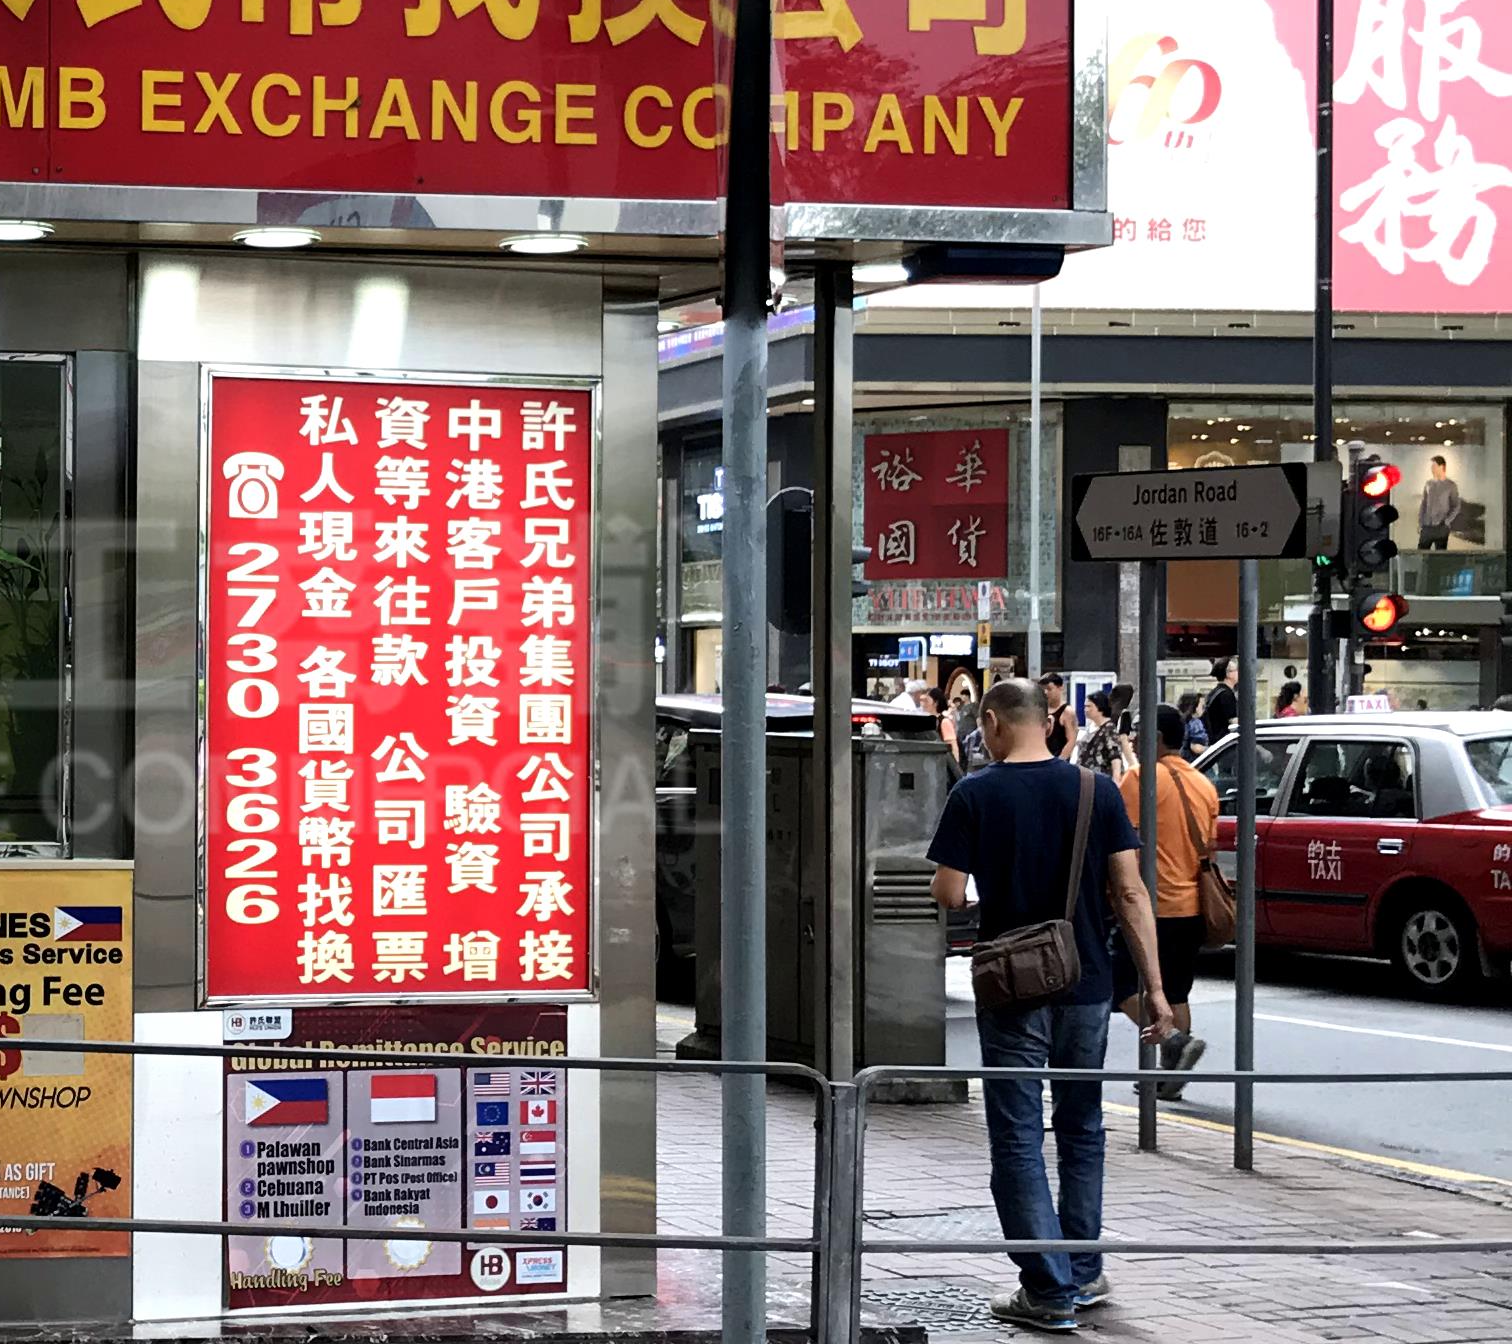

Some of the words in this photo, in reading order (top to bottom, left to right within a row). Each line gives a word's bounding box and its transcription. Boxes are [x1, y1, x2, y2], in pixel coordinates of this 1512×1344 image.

[140, 69, 598, 147] EXCHANGE
[871, 438, 994, 494] 裕華
[1132, 483, 1188, 506] Jordan
[1193, 479, 1238, 503] Road
[298, 393, 359, 619] 私人現金
[370, 396, 431, 688] 資等來往款
[877, 517, 989, 569] 國貨
[1149, 516, 1219, 547] 佐敦道
[445, 399, 504, 747] 中港客戶投資
[225, 542, 281, 719] 2730
[517, 400, 577, 984] 許氏兄弟集團公司承接
[1359, 699, 1389, 710] TAXI
[297, 645, 356, 985] 各國貨幣找換
[224, 747, 281, 926] 3626
[443, 782, 502, 895] 驗資
[371, 731, 430, 984] 公司匯票
[1307, 840, 1342, 860] 的士
[1493, 843, 1511, 862] 的
[1307, 859, 1342, 881] TAXI
[22, 942, 123, 965] Service
[443, 929, 501, 983] 增
[42, 975, 105, 1007] Fee
[470, 1036, 566, 1058] Service
[256, 1141, 321, 1159] Palawan
[363, 1138, 392, 1152] Bank
[393, 1136, 434, 1151] Central
[435, 1136, 459, 1150] Asia
[4, 1163, 22, 1182] AS
[25, 1162, 56, 1182] GIFT
[257, 1158, 335, 1178] pawnshop
[363, 1155, 392, 1169] Bank
[393, 1154, 446, 1168] Sinarmas
[256, 1179, 324, 1198] Cebuana
[363, 1172, 377, 1186] PT
[379, 1172, 400, 1185] Pos
[363, 1188, 392, 1203] Bank
[393, 1187, 431, 1202] Rakyat
[257, 1201, 270, 1219] M
[364, 1202, 420, 1217] Indonesia
[480, 1254, 504, 1276] HB
[230, 1268, 309, 1292] Handling
[313, 1268, 343, 1288] Fee
